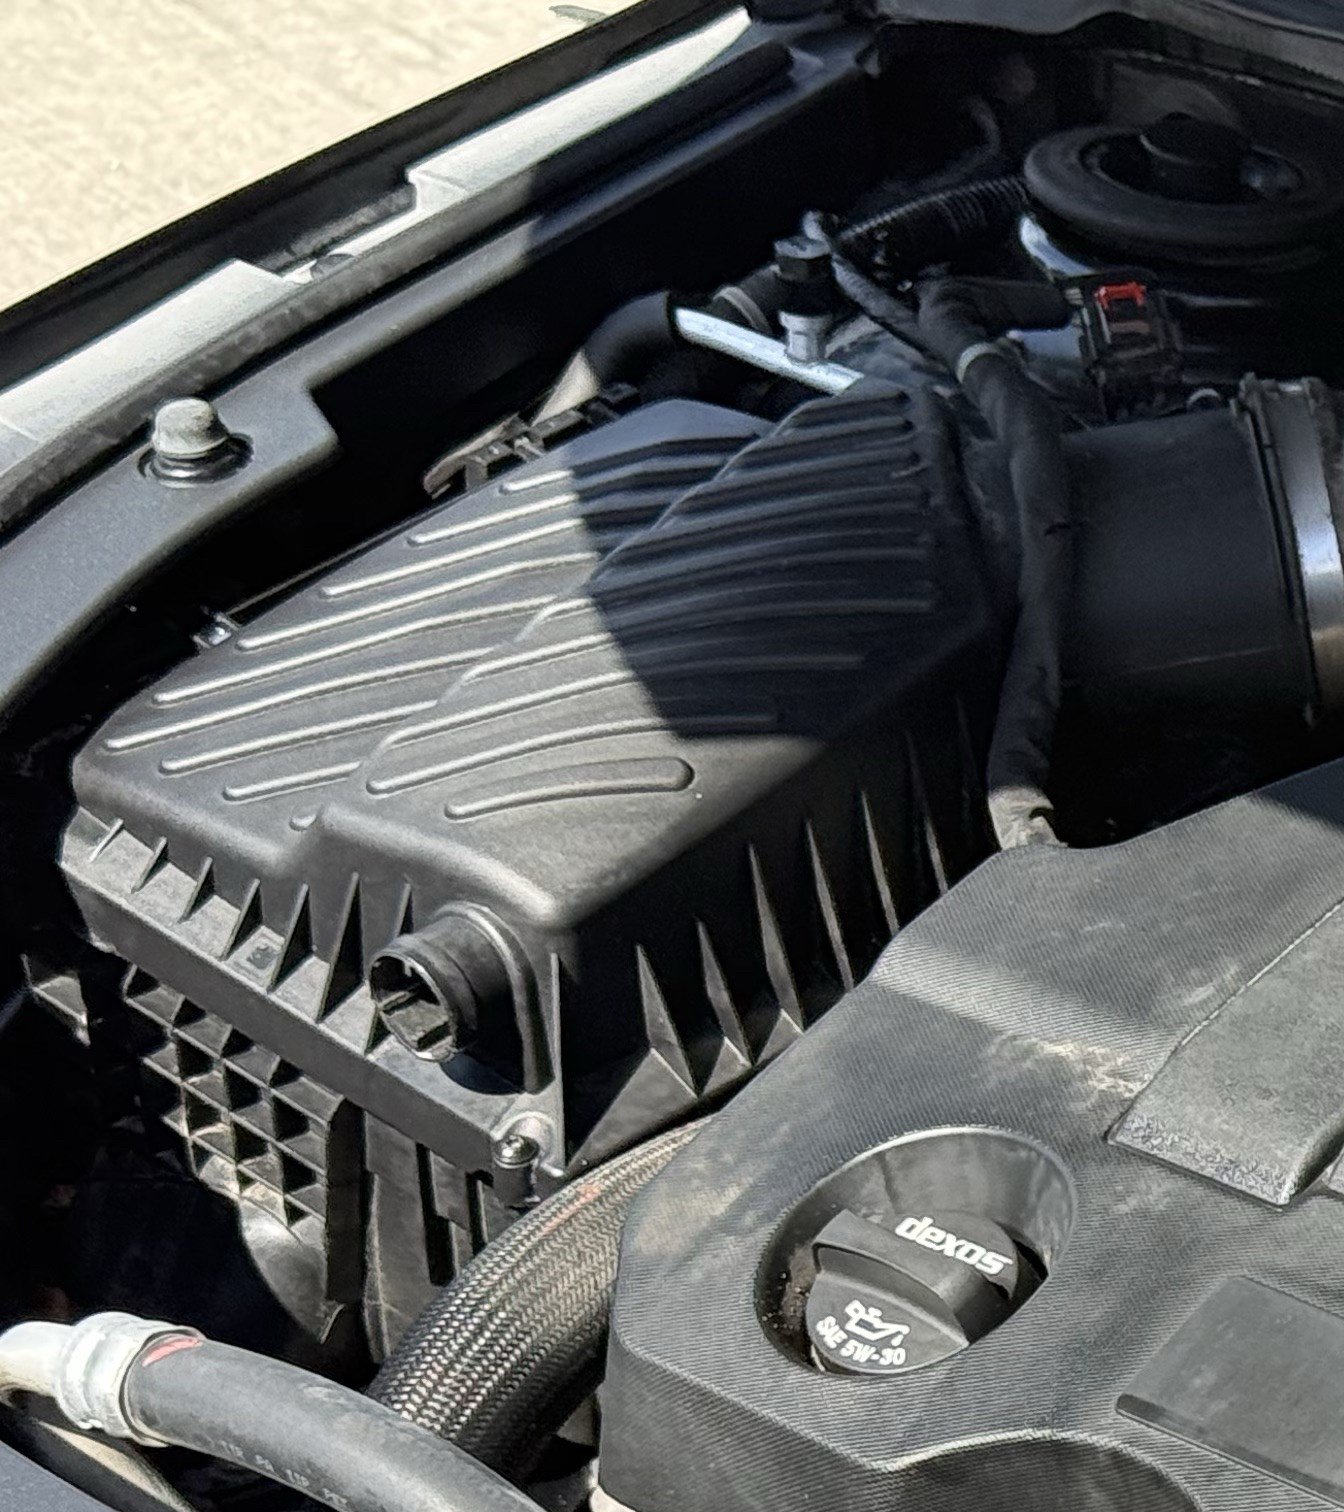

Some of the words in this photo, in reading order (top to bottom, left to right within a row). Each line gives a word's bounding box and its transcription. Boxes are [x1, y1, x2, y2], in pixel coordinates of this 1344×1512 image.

[895, 1216, 1013, 1275] dexos
[816, 1315, 848, 1349] SAE
[840, 1340, 906, 1366] 5W-30
